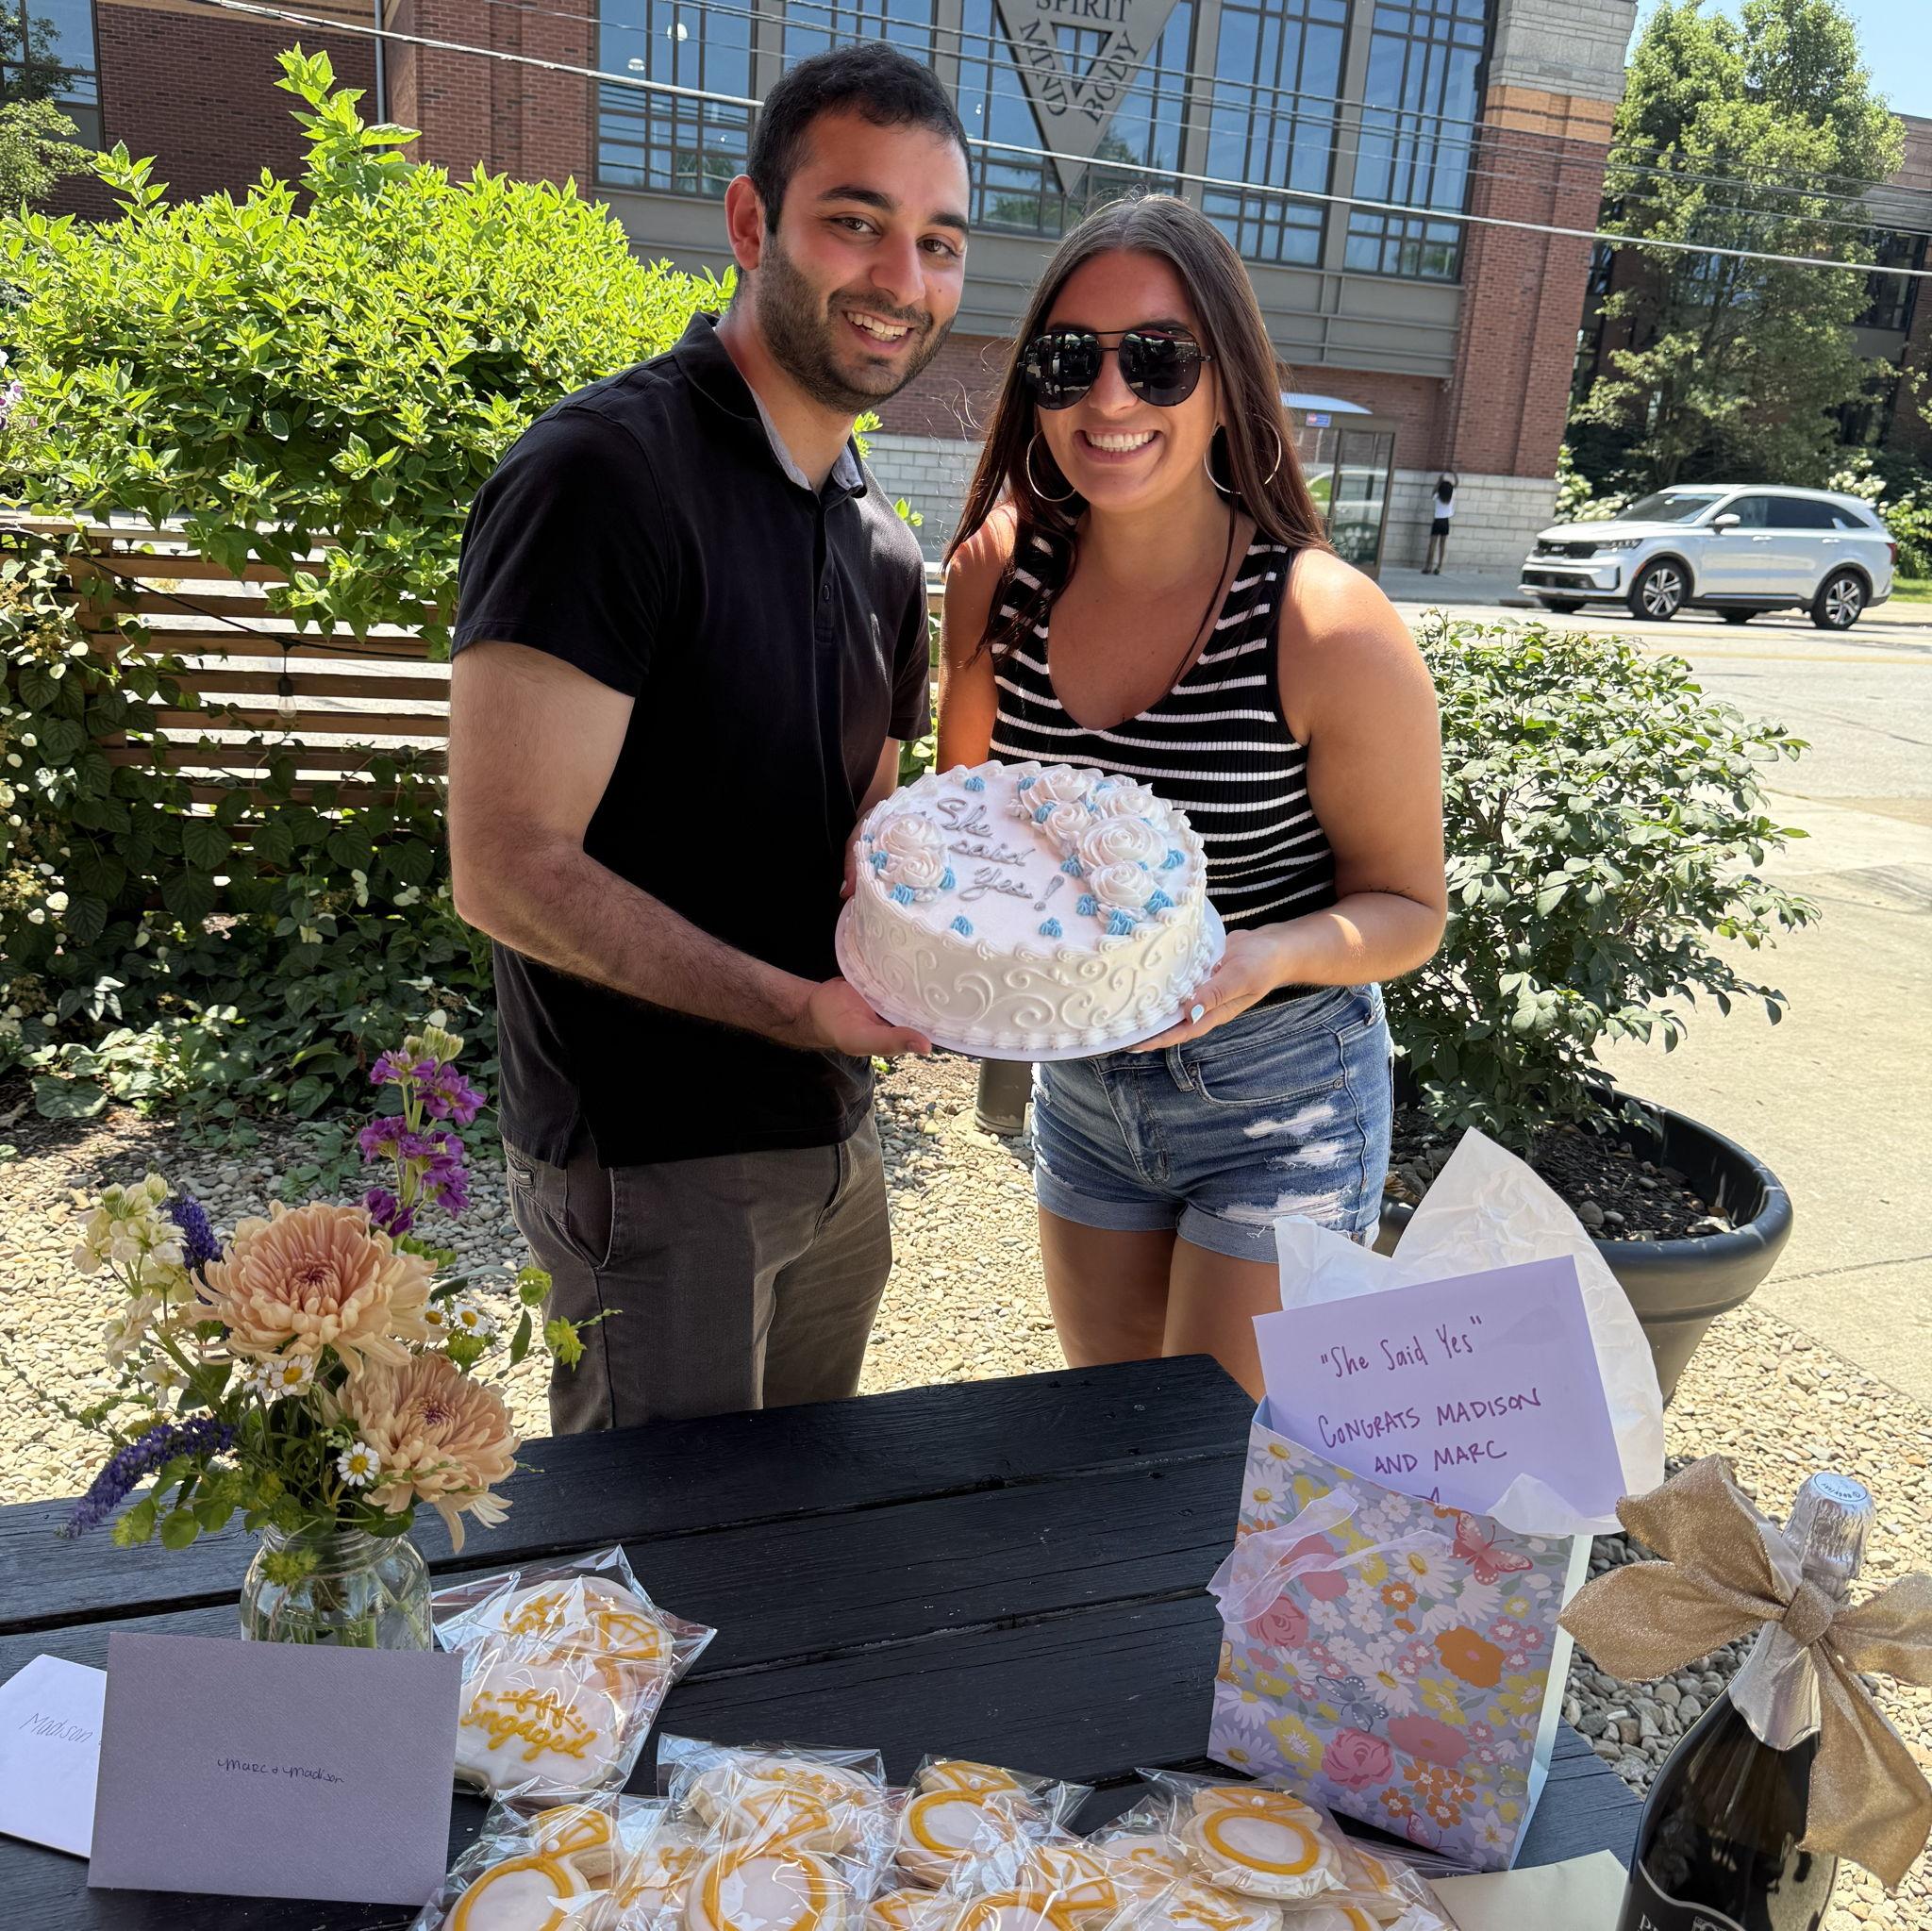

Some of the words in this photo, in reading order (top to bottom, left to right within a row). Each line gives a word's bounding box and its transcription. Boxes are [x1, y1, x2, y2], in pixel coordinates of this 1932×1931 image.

[1019, 18, 1069, 116] MIND
[1079, 29, 1139, 125] BODY
[937, 797, 992, 837] She
[1380, 1336, 1428, 1371] Said
[1318, 1407, 1421, 1449] CONGRATS
[1437, 1388, 1541, 1426] MADISON
[1374, 1453, 1419, 1474] AND
[1433, 1440, 1507, 1472] MARC
[19, 1712, 93, 1743] Madison
